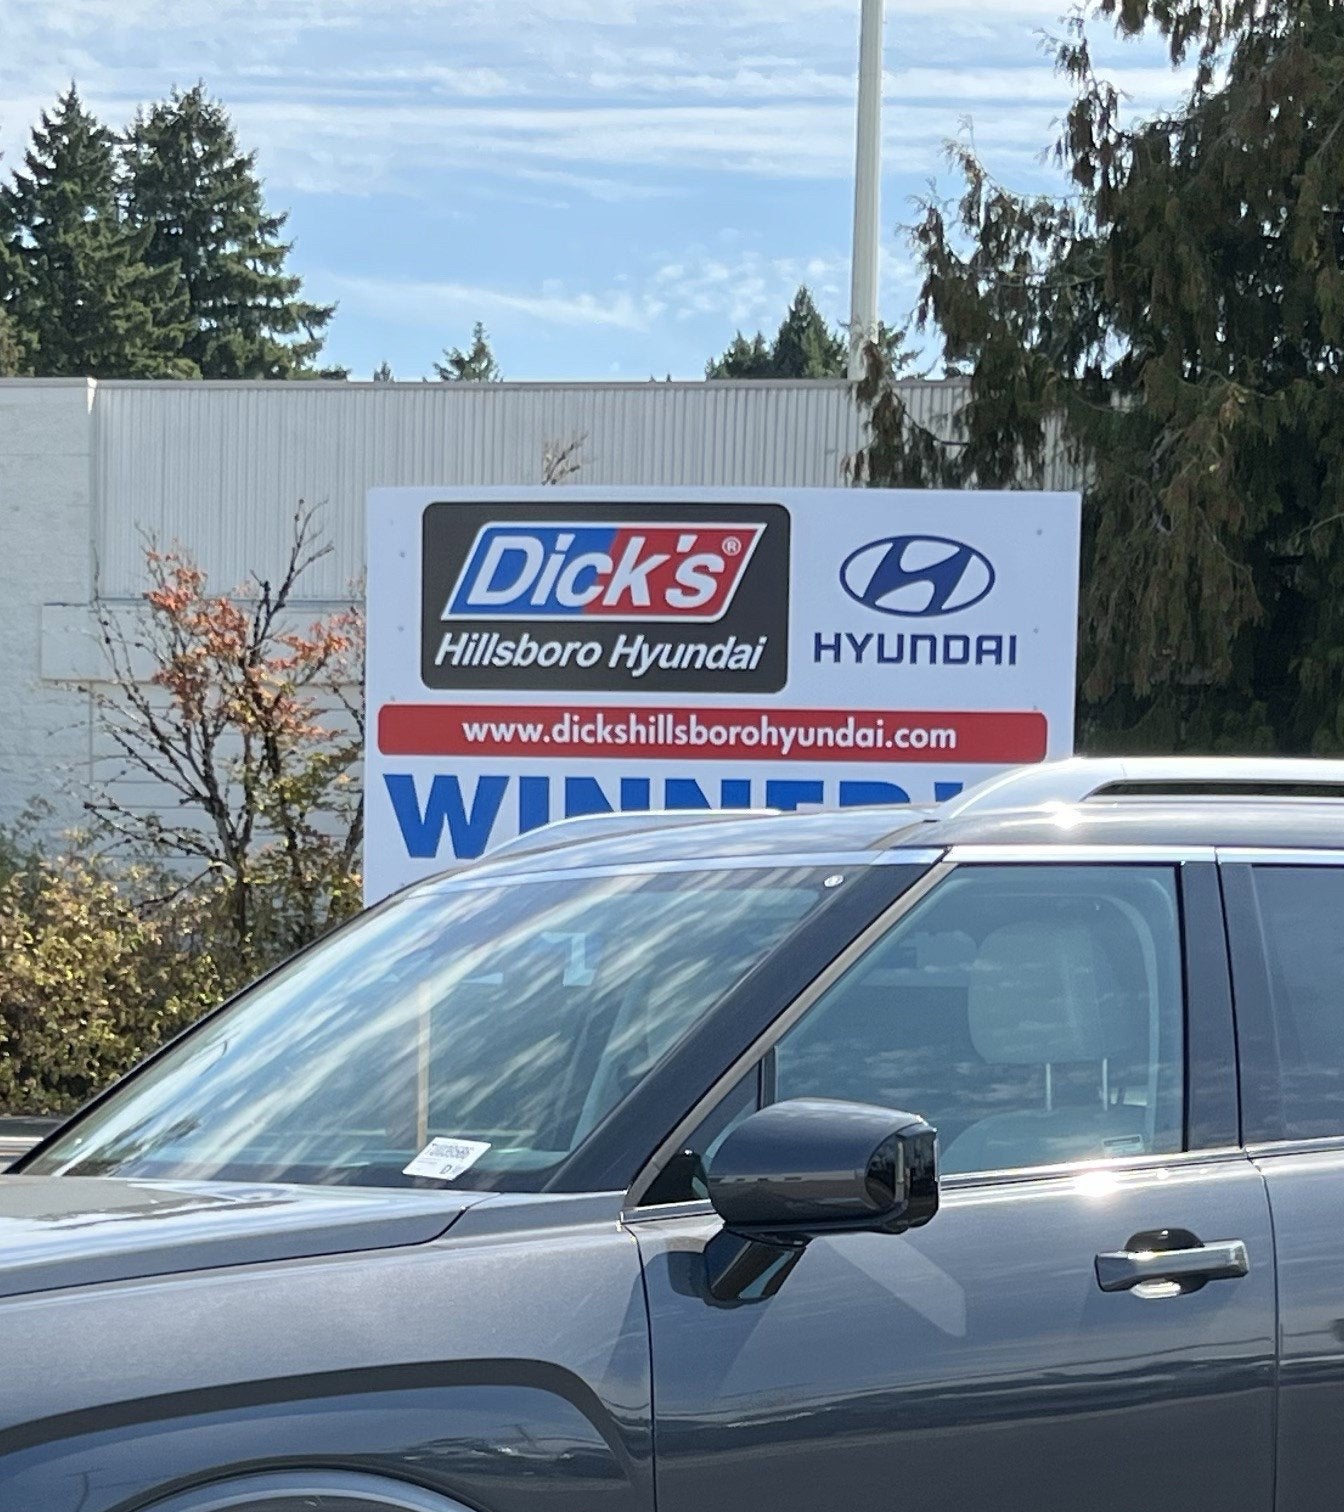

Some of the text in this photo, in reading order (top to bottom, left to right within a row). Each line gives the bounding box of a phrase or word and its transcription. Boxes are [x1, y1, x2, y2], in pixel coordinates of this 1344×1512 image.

[435, 632, 768, 677] Hillsboro Hyundai
[814, 632, 1018, 666] HYUNDAI
[462, 716, 957, 755] www.dickshillsborohyundai.com
